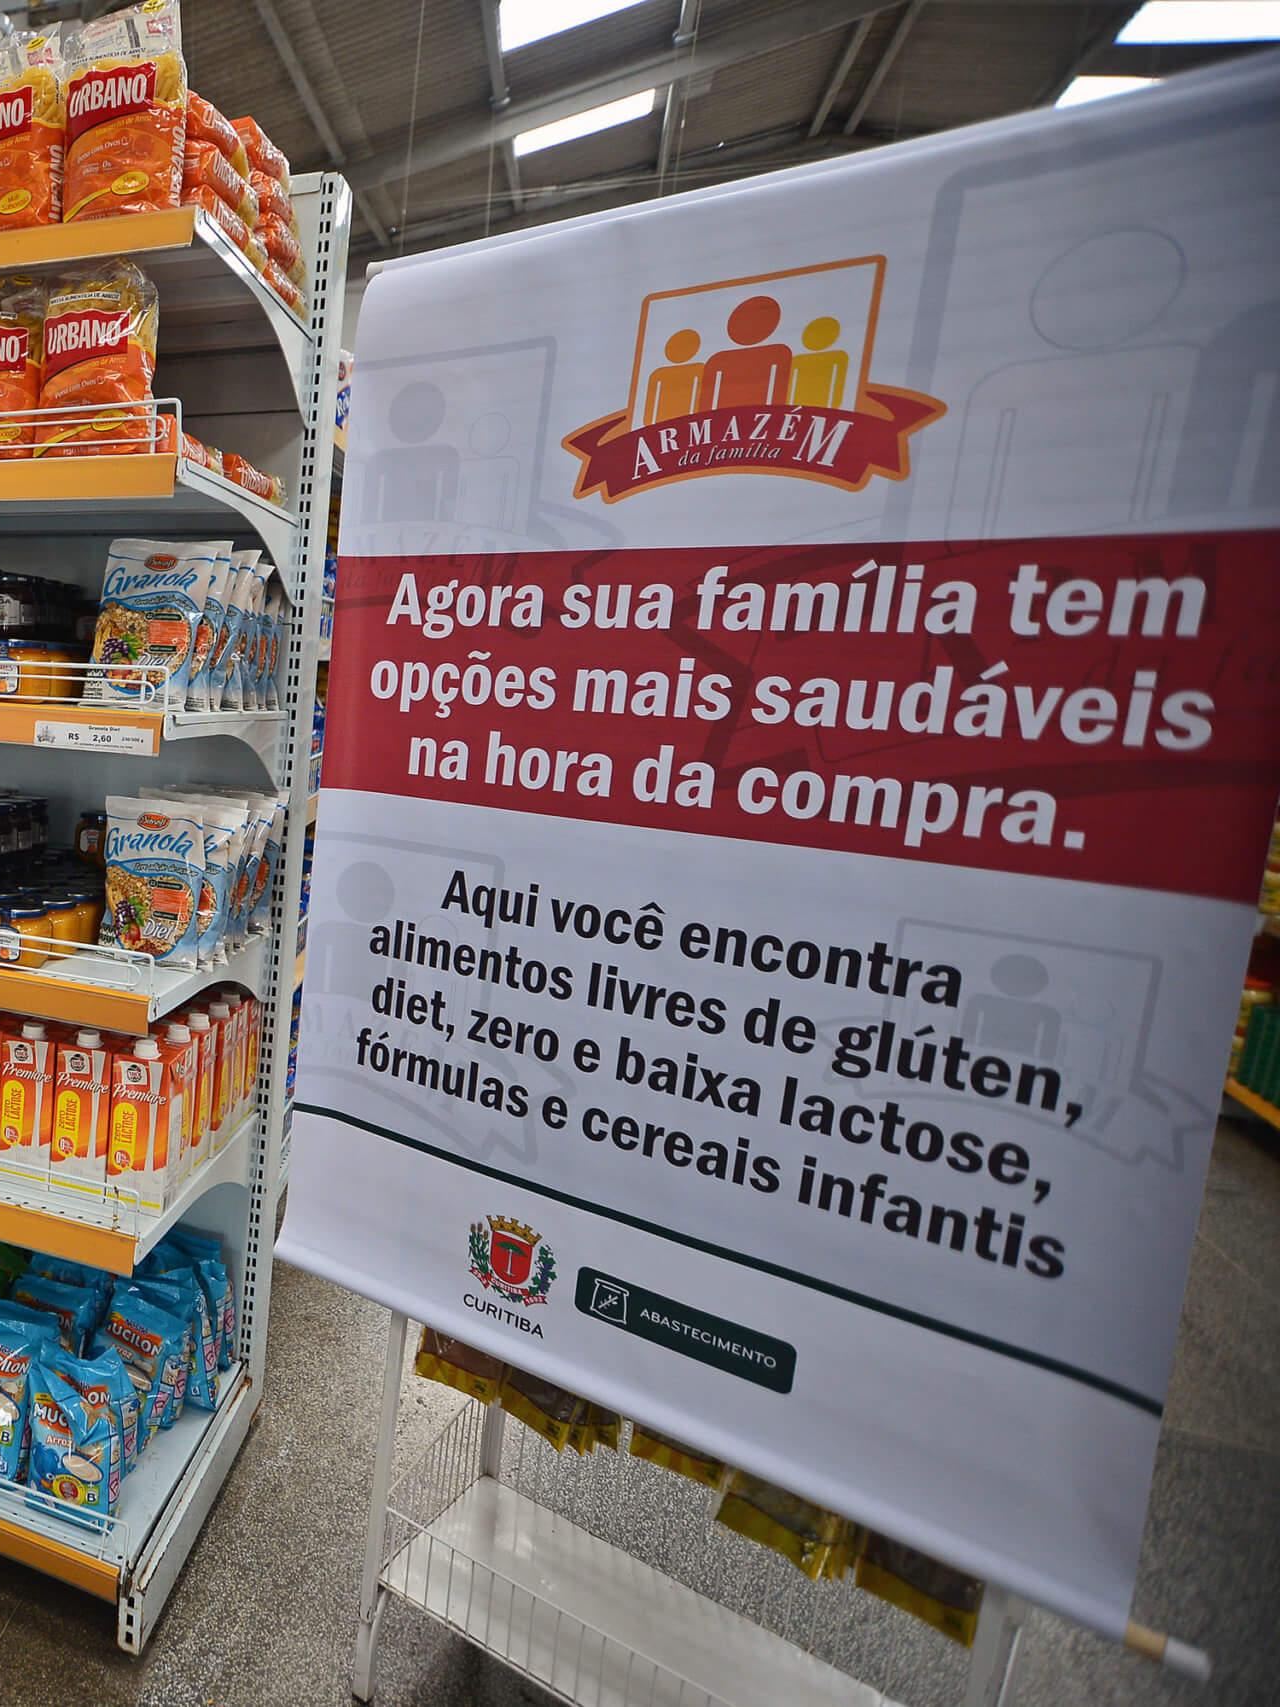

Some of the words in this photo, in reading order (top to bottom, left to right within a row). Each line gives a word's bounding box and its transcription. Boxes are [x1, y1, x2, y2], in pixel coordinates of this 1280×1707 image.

[69, 74, 147, 118] URBANO
[169, 126, 186, 207] URBANO
[47, 320, 120, 354] URBANO
[631, 404, 855, 481] ARMAZÉM
[678, 449, 701, 468] da
[705, 441, 782, 467] família
[103, 567, 198, 597] Granola
[385, 572, 545, 640] Agora
[559, 582, 675, 632] sua
[696, 558, 978, 635] família
[1008, 563, 1207, 639] tem
[370, 650, 558, 720] opções
[571, 657, 733, 722] mais
[751, 660, 1216, 752] saudáveis
[68, 732, 80, 741] R$
[92, 734, 112, 744] 2,60
[407, 734, 470, 783] na
[484, 730, 614, 799] hora
[632, 744, 716, 810] da
[737, 764, 1086, 851] compra.
[106, 827, 194, 859] Granola
[440, 869, 540, 929] Aqui
[550, 900, 666, 951] você
[679, 921, 963, 1008] encontra
[368, 919, 574, 1001] alimentos
[586, 962, 728, 1037] livres
[743, 997, 818, 1055] de
[830, 1020, 1085, 1129] glúten,
[3, 1061, 53, 1083] Premiare
[58, 1072, 110, 1095] Premiare
[371, 977, 456, 1043] diet,
[466, 1008, 560, 1063] zero
[572, 1037, 602, 1074] e
[615, 1036, 762, 1117] baixa
[779, 1076, 1052, 1206] lactose,
[11, 1087, 23, 1121] LACTOSE
[112, 1083, 167, 1106] Premiare
[65, 1097, 78, 1132] LACTOSE
[121, 1110, 135, 1145] LACTOSE
[356, 1026, 530, 1119] fórmulas
[541, 1094, 569, 1130] e
[581, 1107, 781, 1194] cereais
[797, 1154, 1066, 1280] infantis
[463, 1293, 544, 1340] CURITIBA
[639, 1307, 777, 1370] ABASTECIMENTO
[46, 1434, 74, 1448] Arroz
